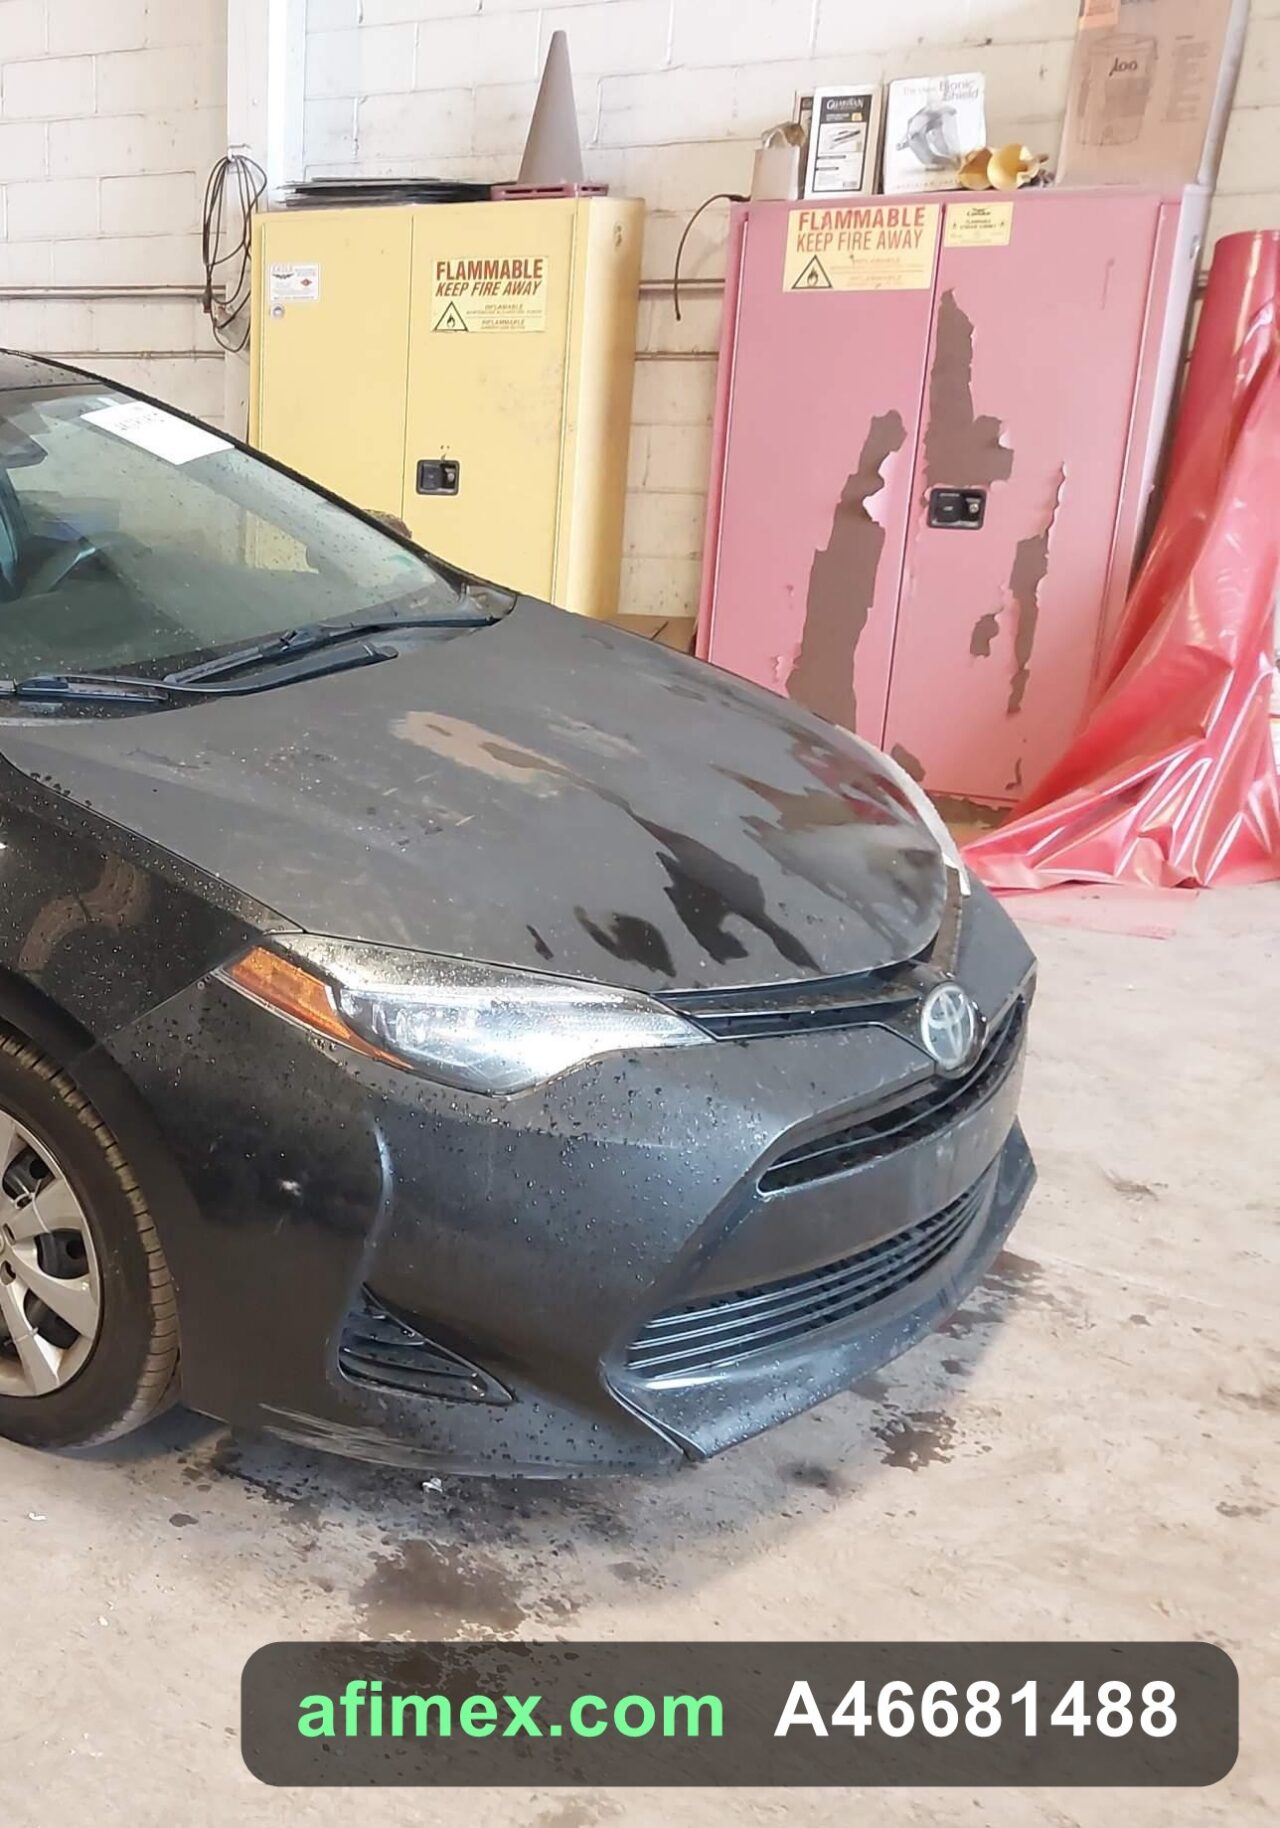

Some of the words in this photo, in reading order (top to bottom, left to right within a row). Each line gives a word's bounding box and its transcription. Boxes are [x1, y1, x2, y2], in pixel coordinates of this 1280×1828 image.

[798, 207, 926, 231] FLAMMABLE
[796, 232, 833, 252] KEEP
[837, 230, 872, 251] FIRE
[876, 229, 923, 250] AWAY
[436, 259, 544, 280] FLAMMABLE
[435, 281, 469, 296] KEEP
[471, 281, 501, 296] FIRE
[502, 280, 542, 296] AWAY
